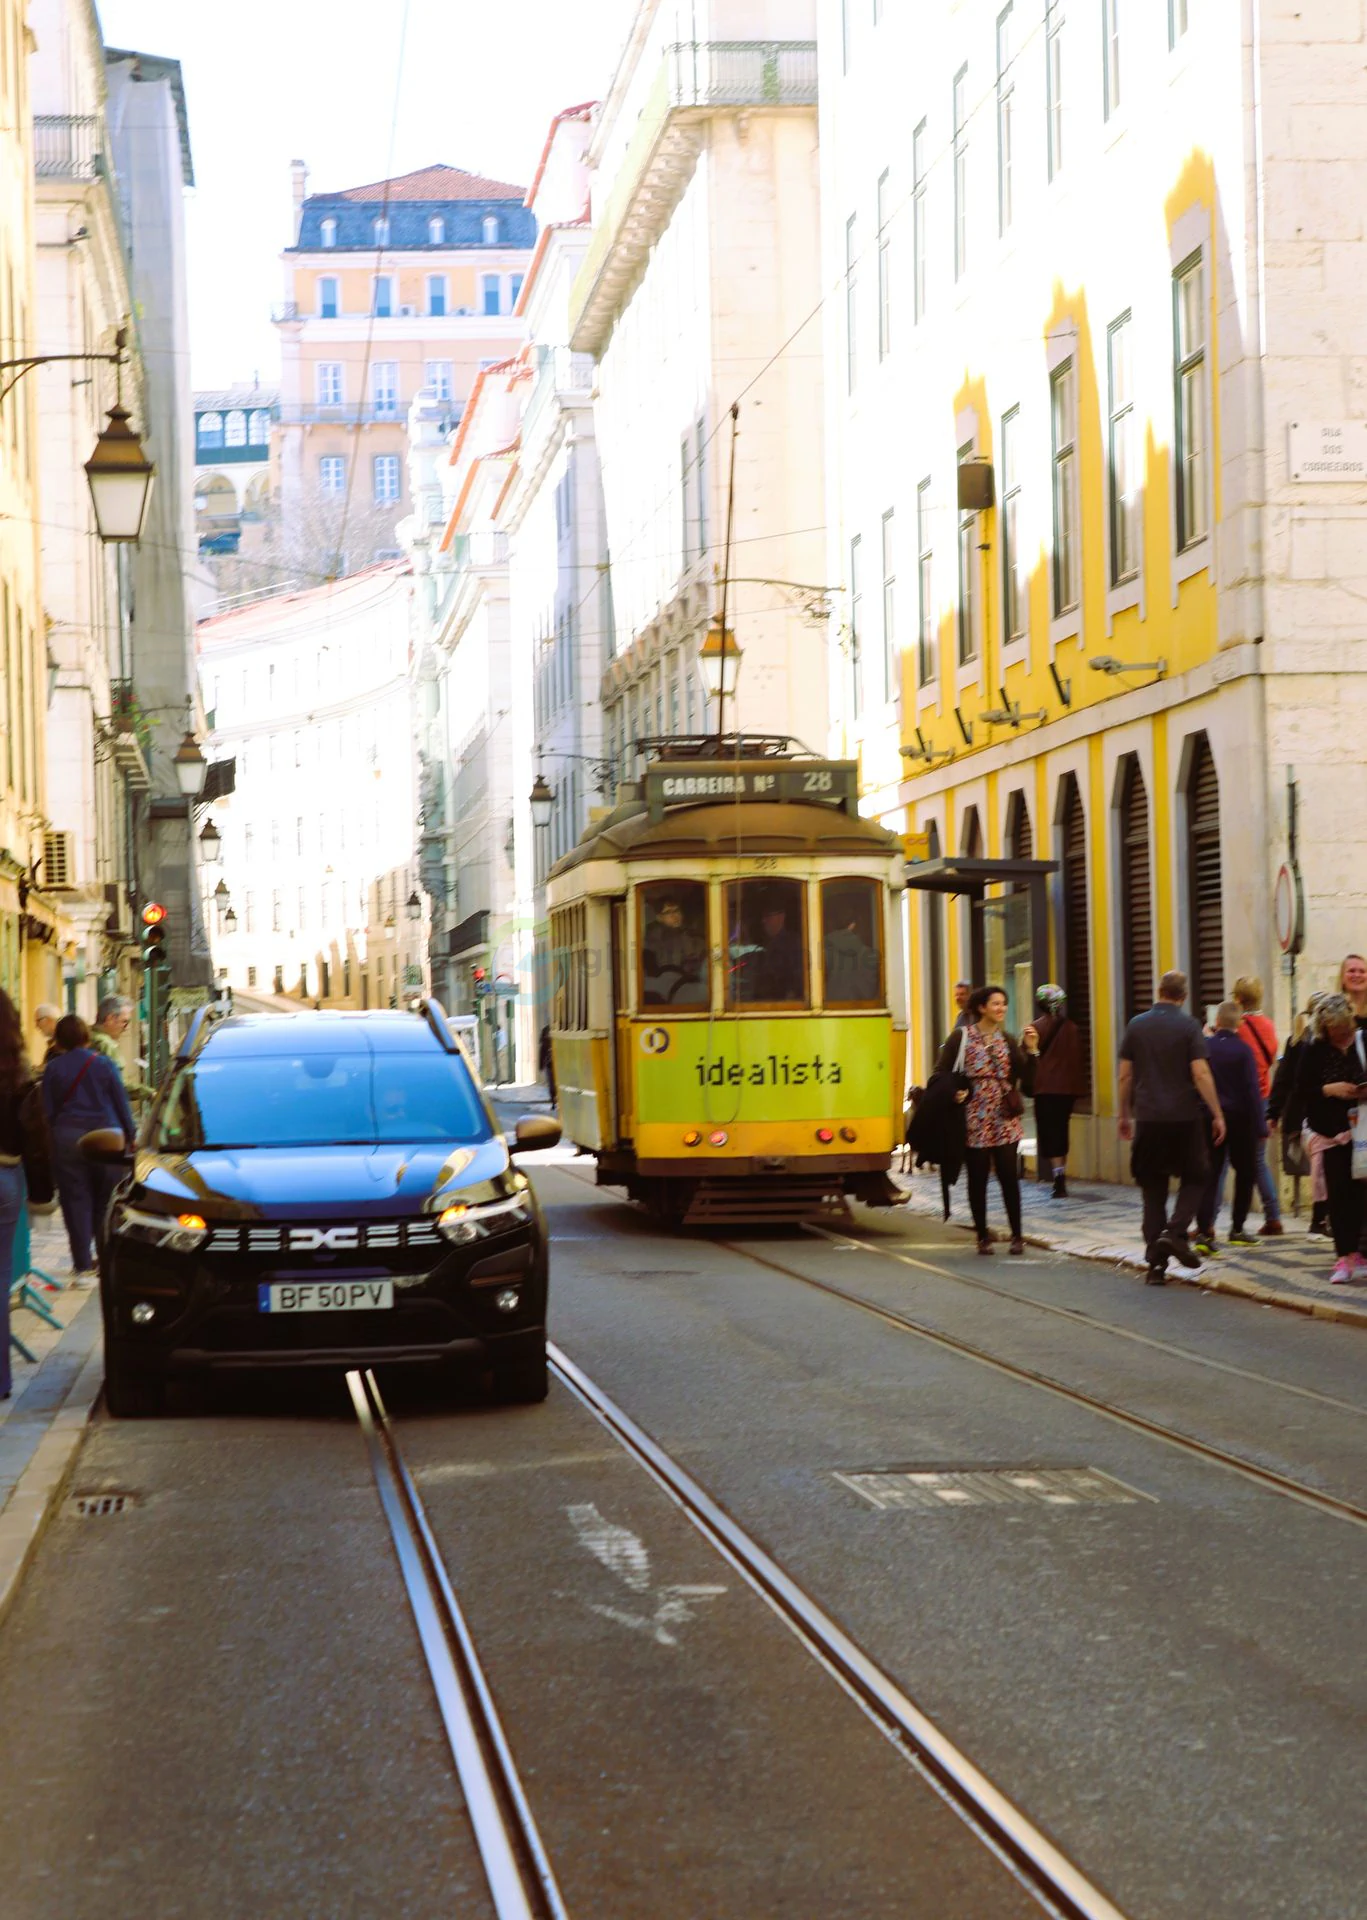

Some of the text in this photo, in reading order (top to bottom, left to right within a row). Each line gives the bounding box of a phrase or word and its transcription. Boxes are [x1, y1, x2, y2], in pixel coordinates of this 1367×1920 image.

[662, 775, 746, 796] CARREIRA
[803, 771, 833, 792] 28
[695, 1054, 842, 1086] idealista
